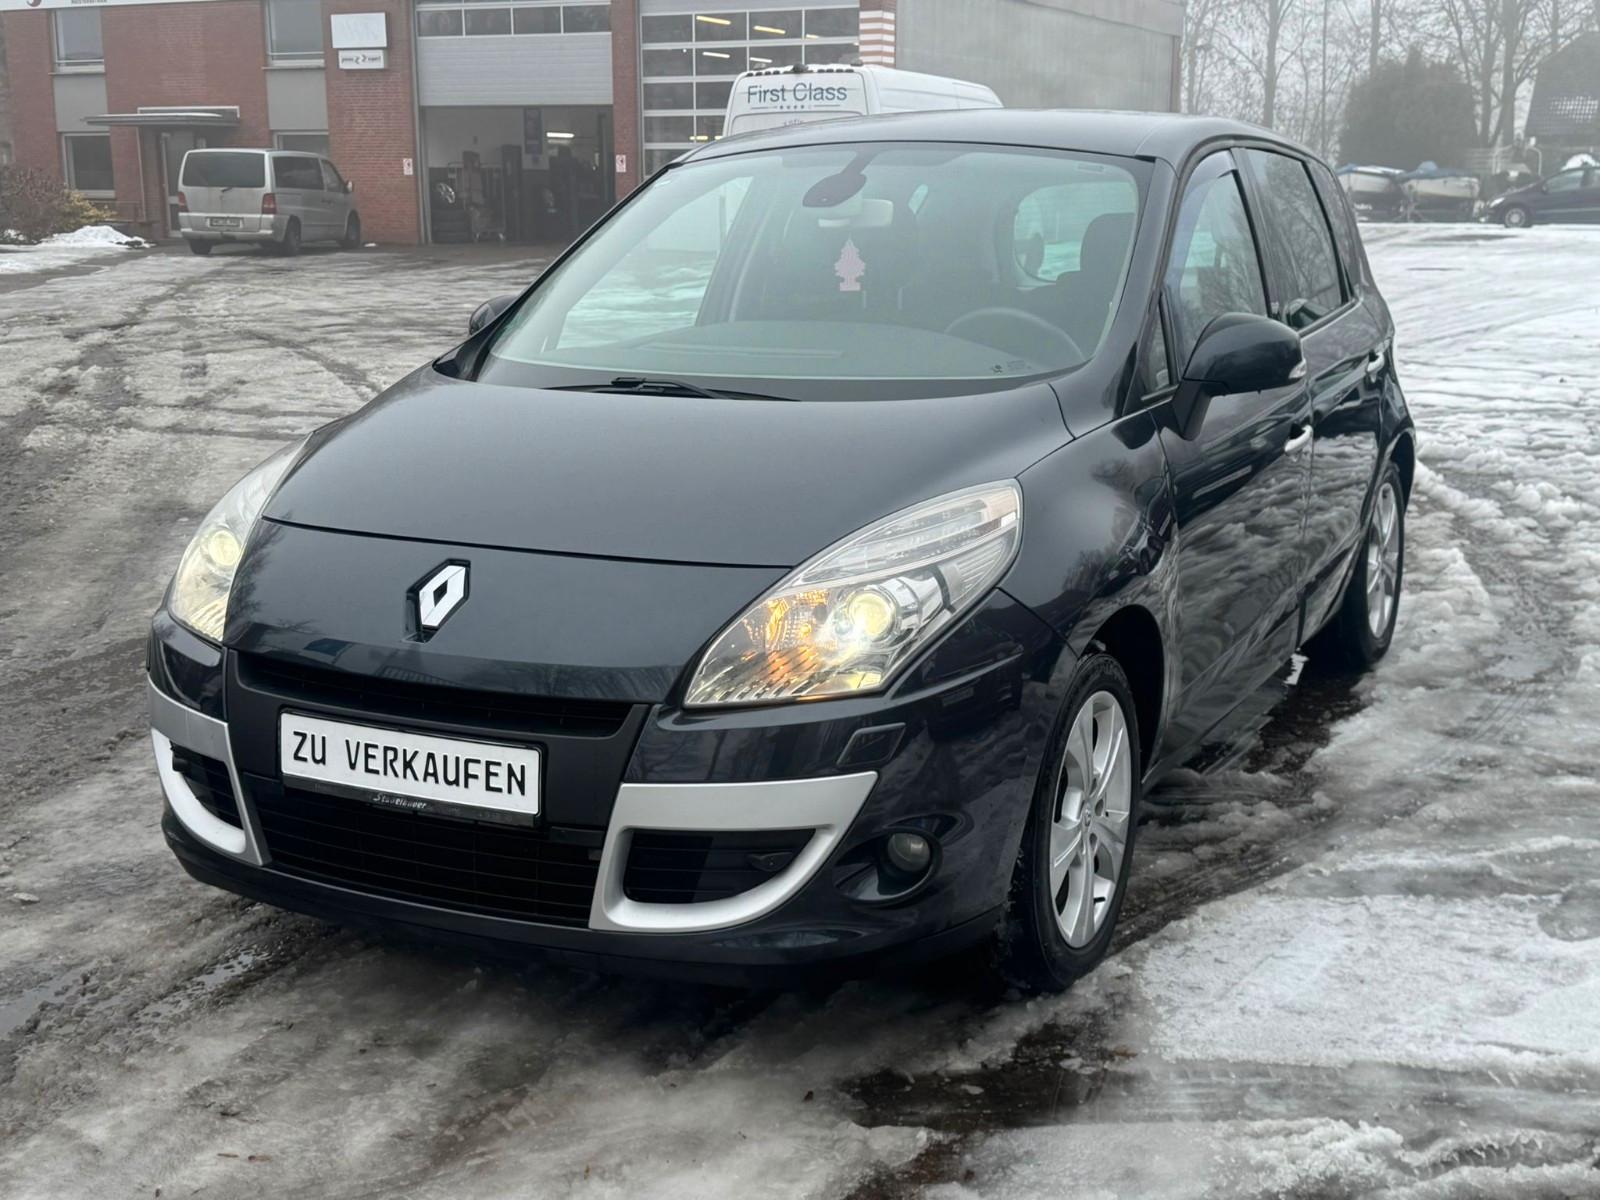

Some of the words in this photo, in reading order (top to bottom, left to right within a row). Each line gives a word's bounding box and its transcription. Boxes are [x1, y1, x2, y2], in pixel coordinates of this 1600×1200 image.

[747, 84, 787, 104] First
[793, 82, 847, 101] Class
[293, 731, 326, 766] ZU
[345, 739, 526, 796] VERKAUFEN
